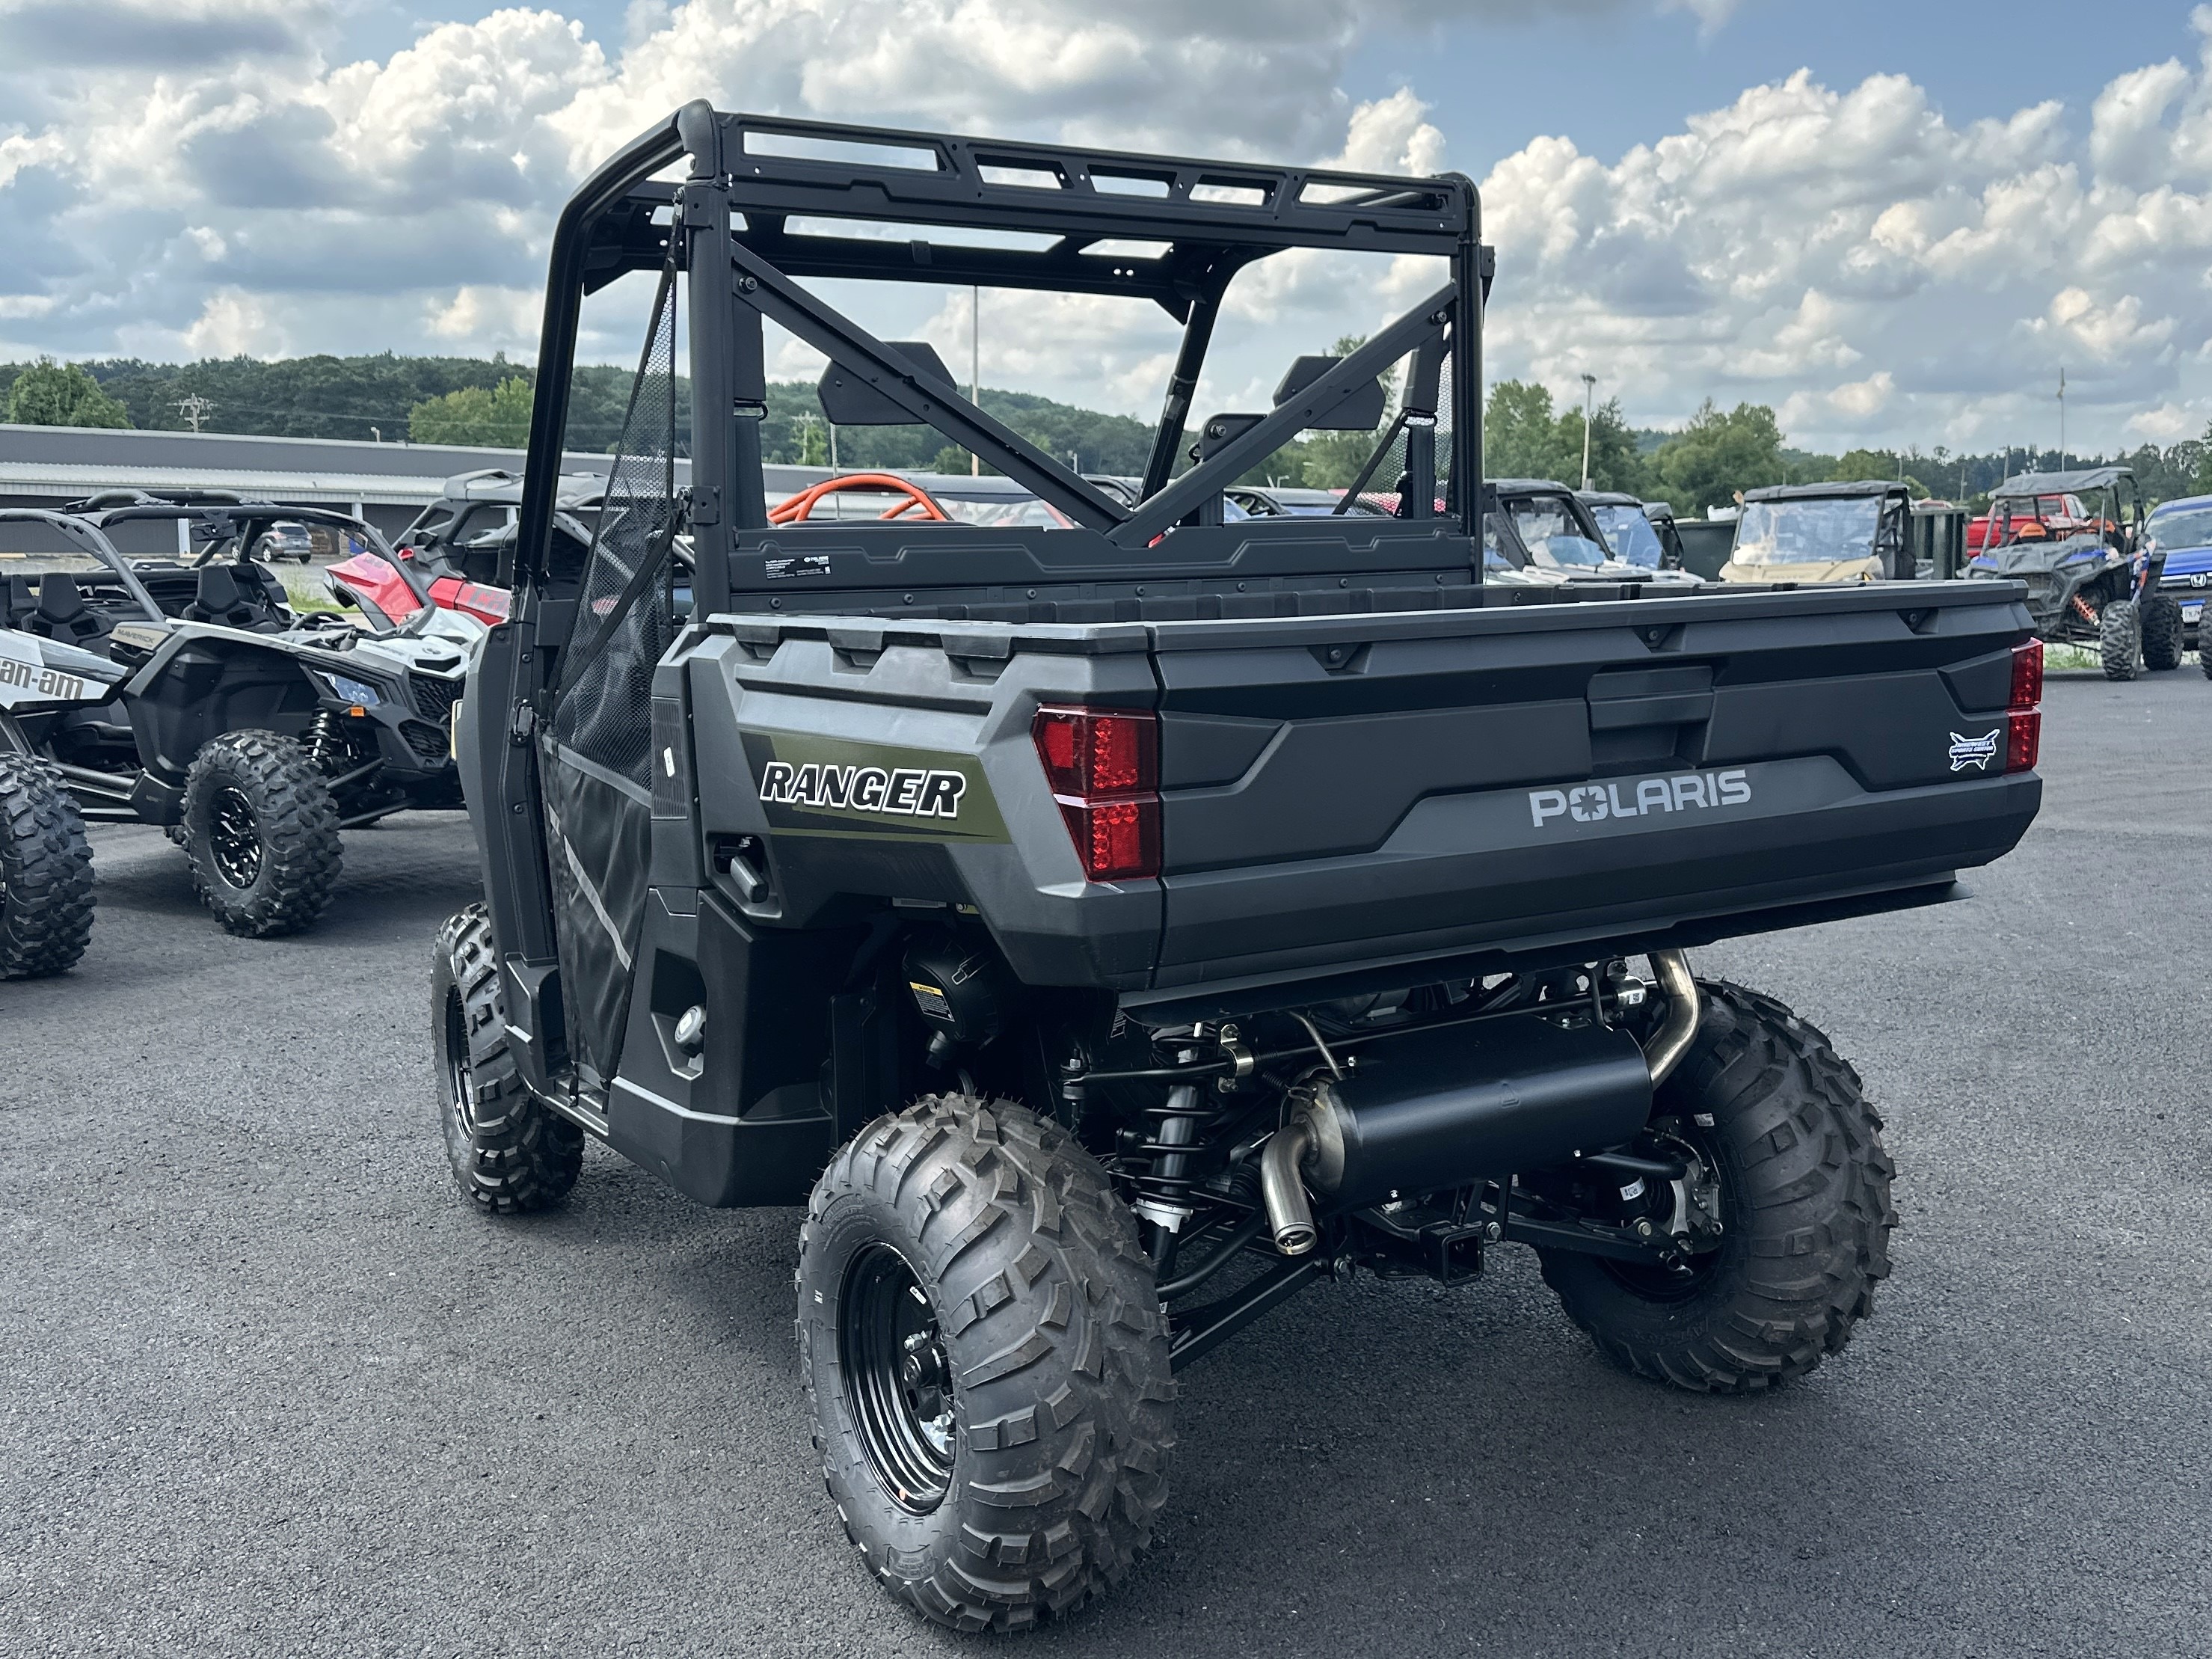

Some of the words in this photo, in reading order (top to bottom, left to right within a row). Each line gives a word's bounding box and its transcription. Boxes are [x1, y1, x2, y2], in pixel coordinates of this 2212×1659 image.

[0, 660, 85, 700] an-am
[760, 761, 966, 818] RANGER
[1529, 770, 1751, 827] POLARIS
